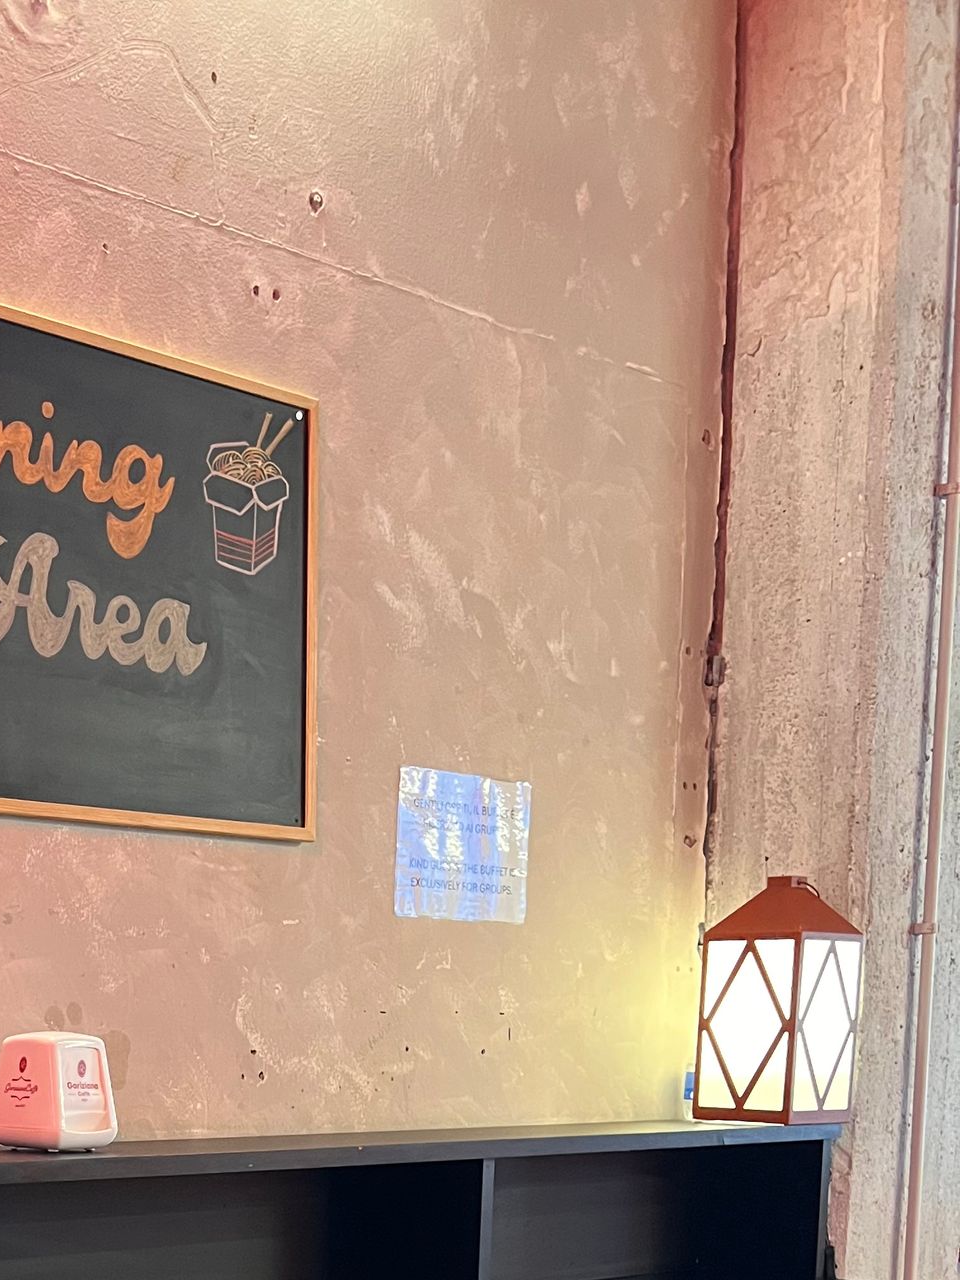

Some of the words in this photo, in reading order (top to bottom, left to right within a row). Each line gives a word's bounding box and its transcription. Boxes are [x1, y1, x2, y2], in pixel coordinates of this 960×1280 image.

[409, 858, 429, 869] KIND
[463, 863, 478, 874] THE
[480, 864, 508, 877] BUFFET
[410, 876, 461, 891] EXCLUSIVELY
[462, 881, 478, 892] FOR
[480, 882, 513, 895] GROUPS.
